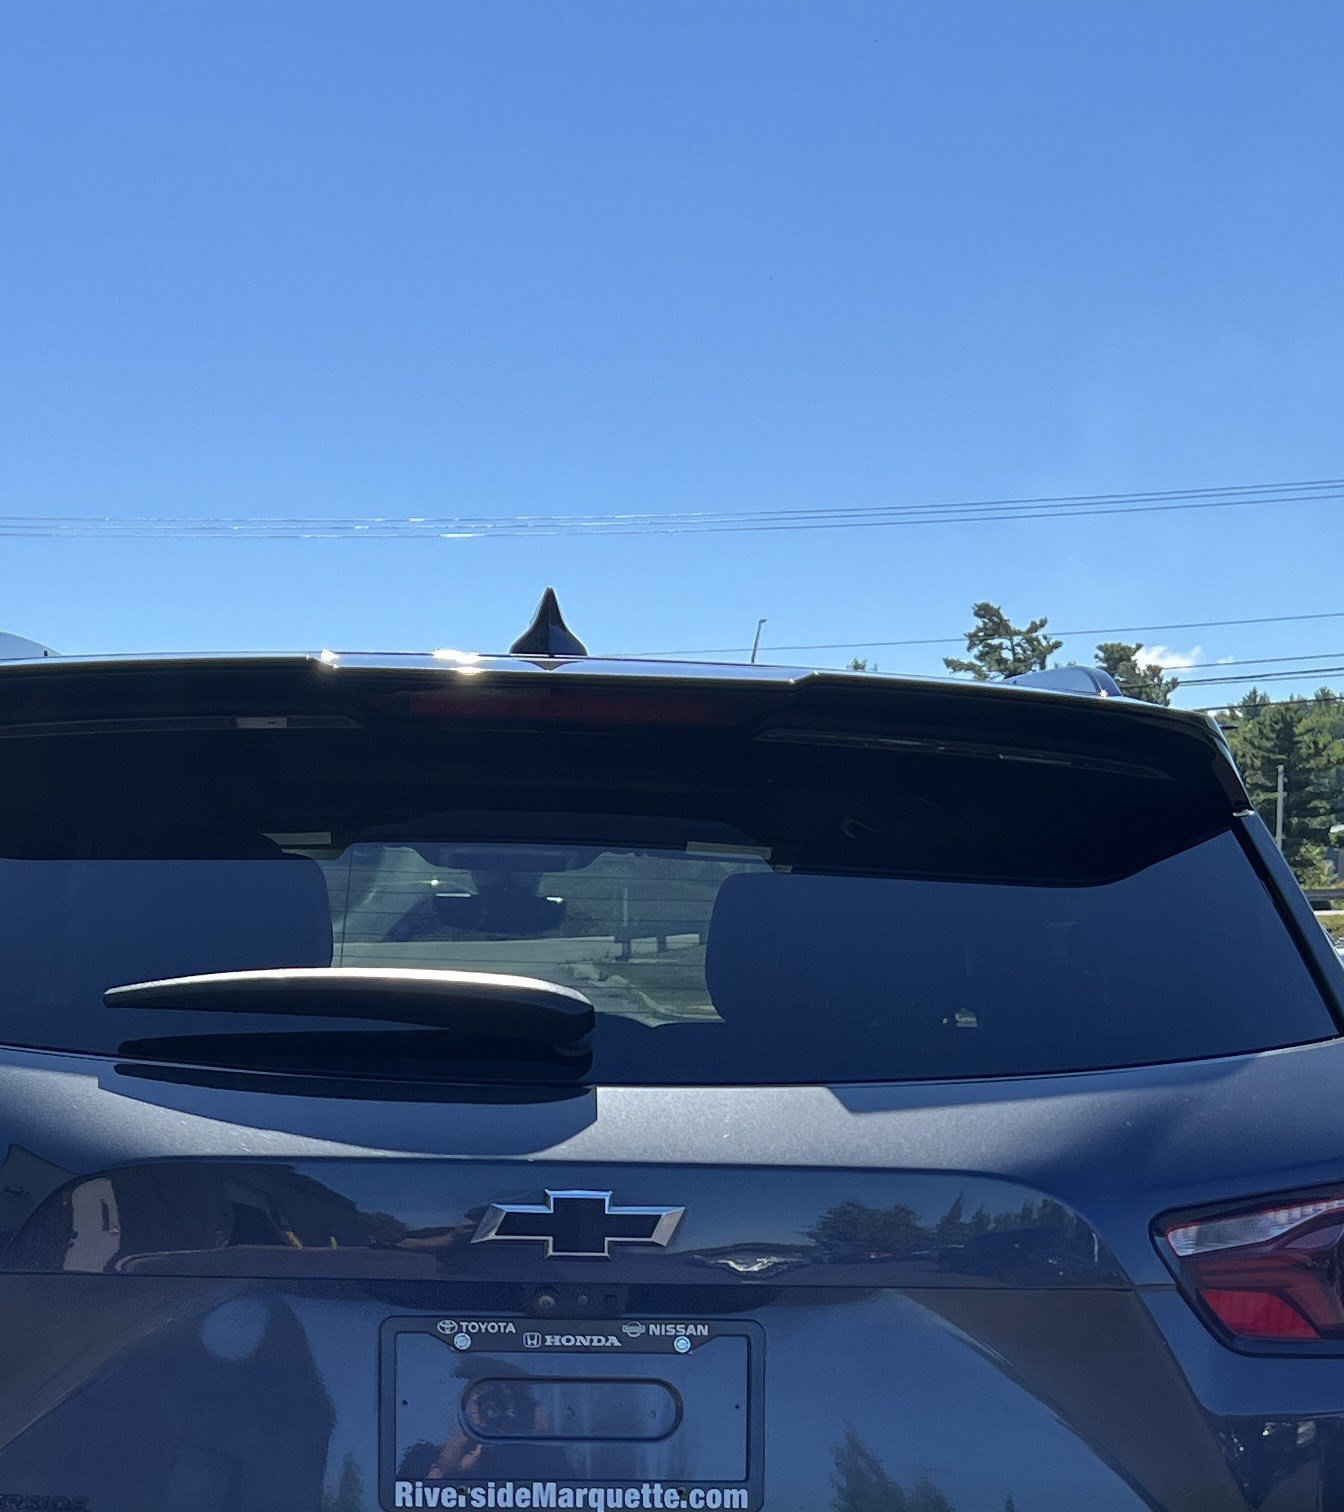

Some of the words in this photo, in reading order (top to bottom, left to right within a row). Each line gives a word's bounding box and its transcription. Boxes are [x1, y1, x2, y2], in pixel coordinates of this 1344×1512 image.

[459, 1321, 517, 1334] TOYOTA
[648, 1323, 709, 1336] NISSAN
[544, 1335, 622, 1347] HONDA
